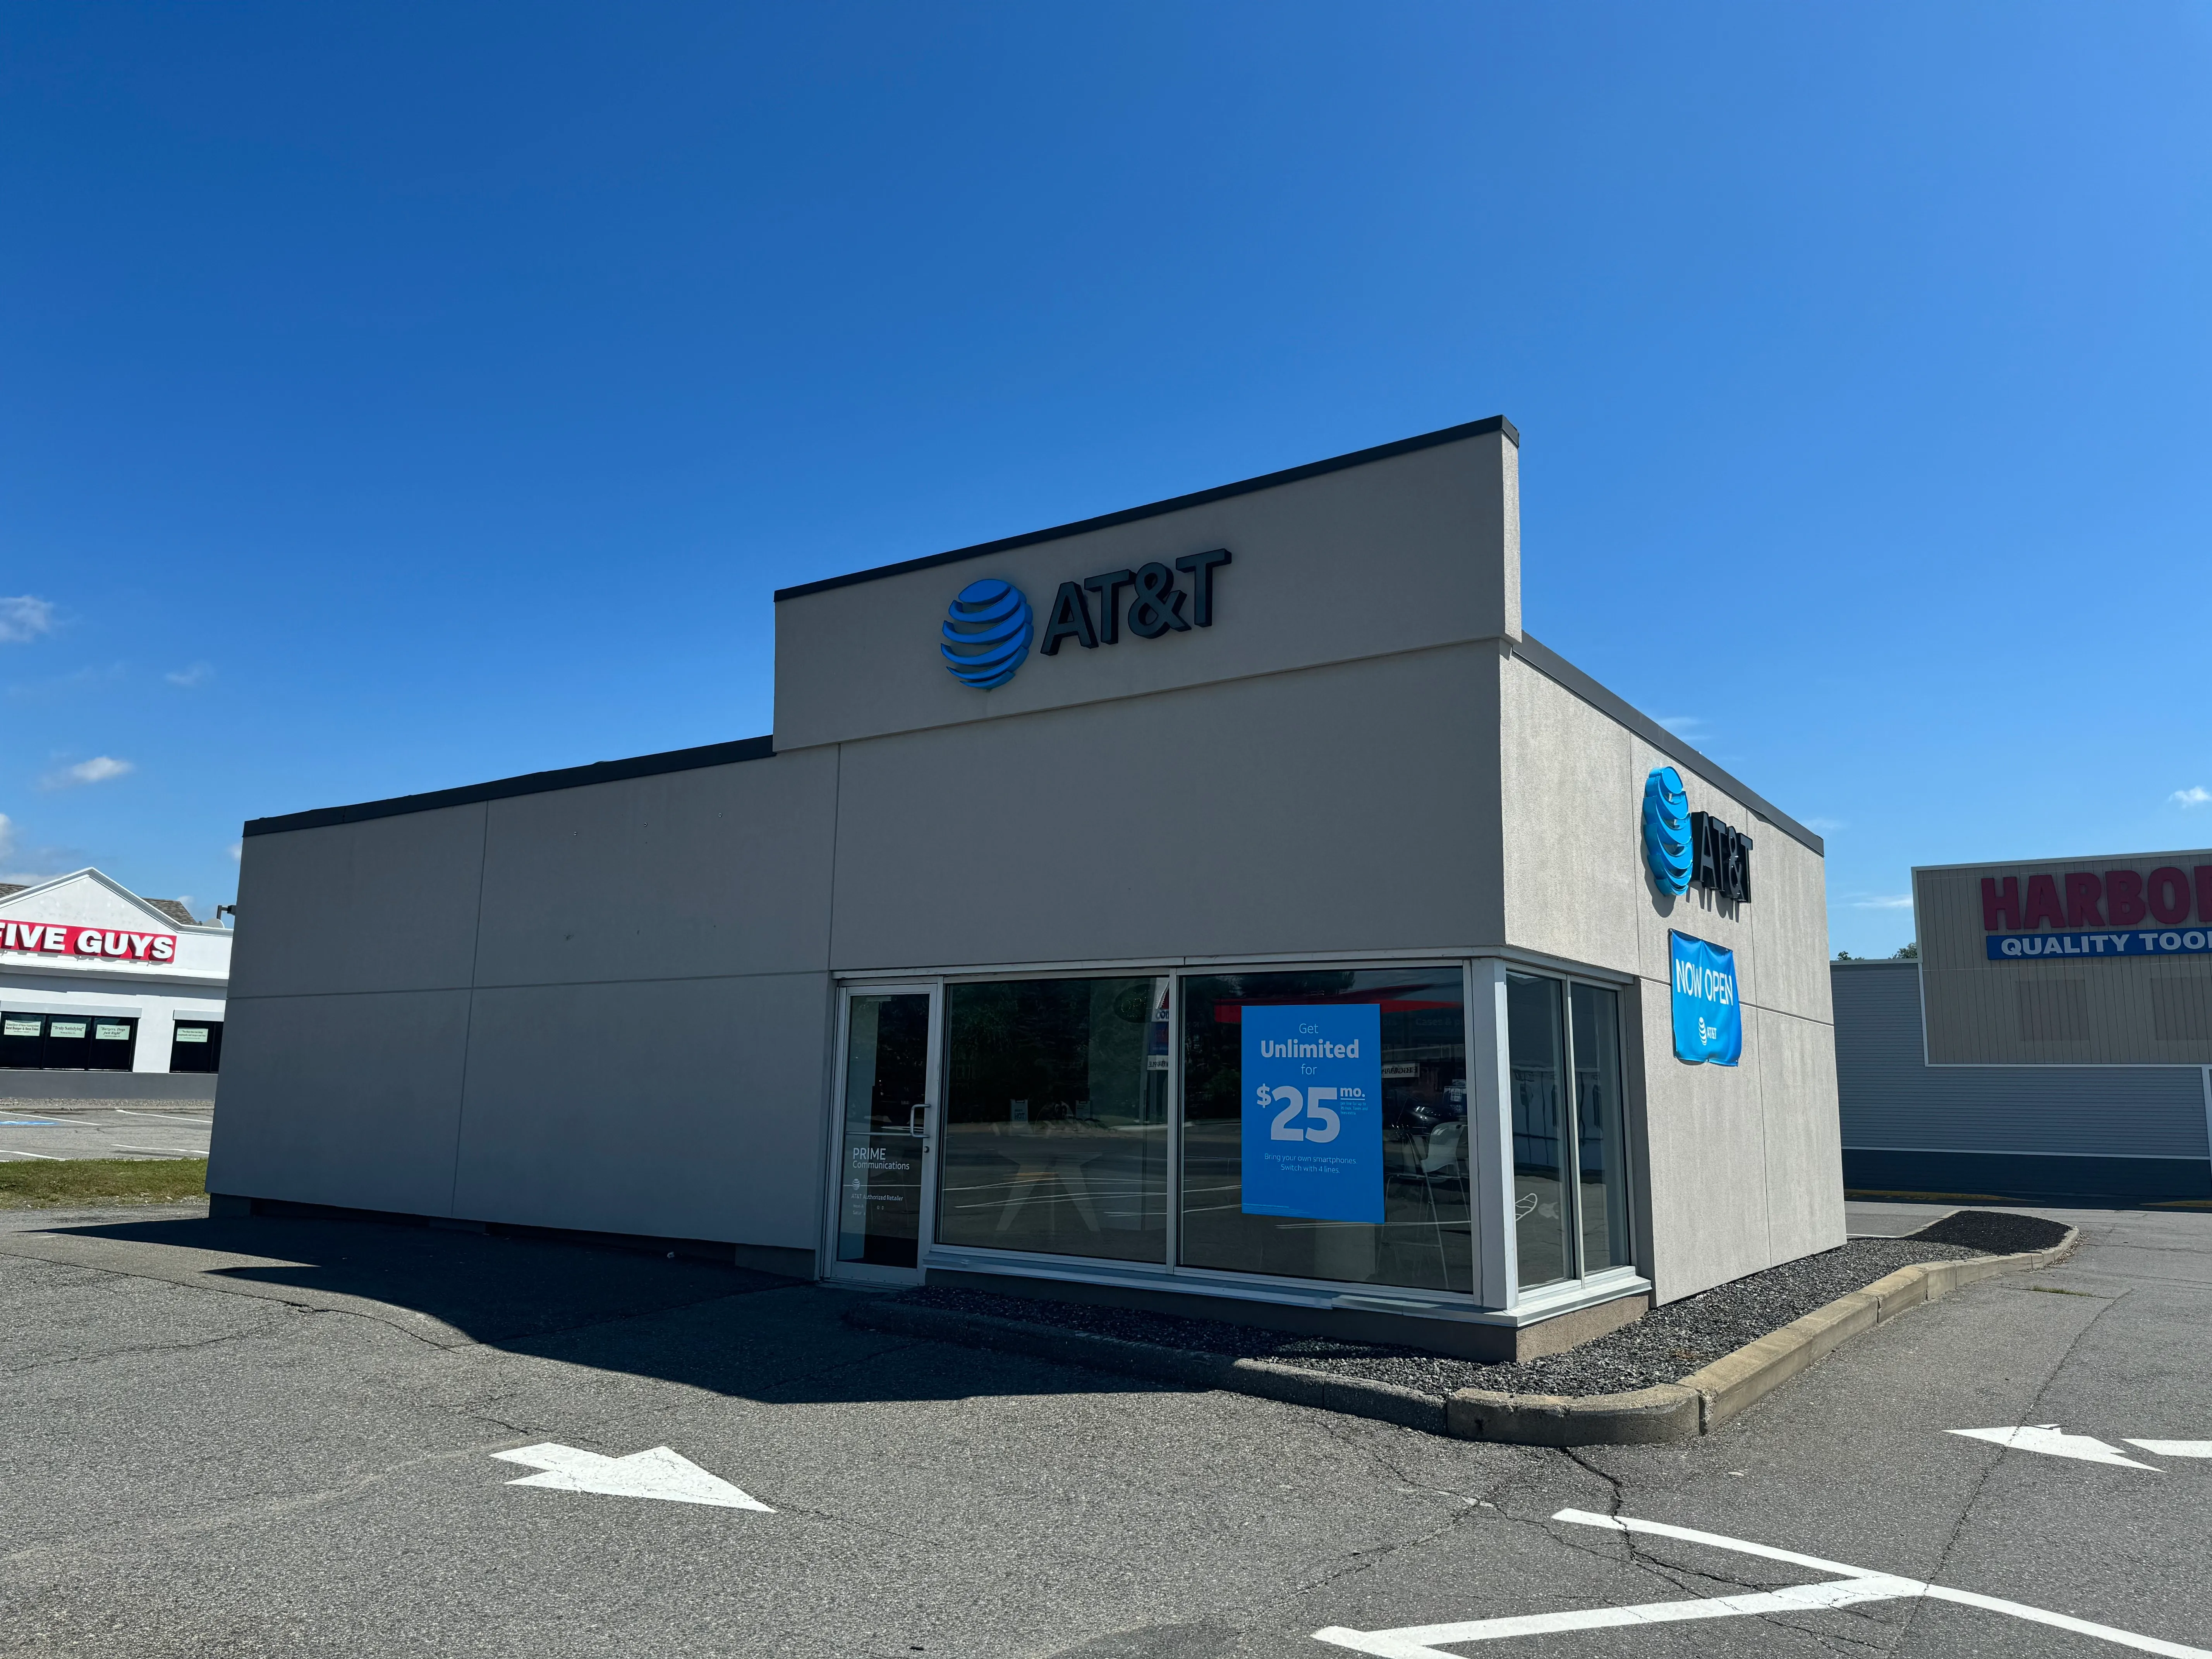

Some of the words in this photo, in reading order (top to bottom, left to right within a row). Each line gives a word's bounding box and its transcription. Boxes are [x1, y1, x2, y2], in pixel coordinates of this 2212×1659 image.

[1040, 548, 1231, 656] AT&T
[1691, 811, 1753, 903] AT&T
[0, 922, 67, 950] IVE
[78, 930, 173, 958] GUYS
[2001, 934, 2130, 956] QUALITY
[2139, 931, 2212, 951] TOO
[1676, 958, 1702, 998] NOW
[1705, 969, 1733, 1006] OPEN
[1299, 1024, 1319, 1034] Get
[1707, 1027, 1717, 1039] AT&T
[1261, 1039, 1359, 1058] Unlimited
[1301, 1064, 1317, 1075] for
[1340, 1087, 1365, 1097] mo.
[853, 1147, 886, 1160] PRIME
[1265, 1153, 1280, 1162] Bring
[853, 1161, 910, 1170] Communications
